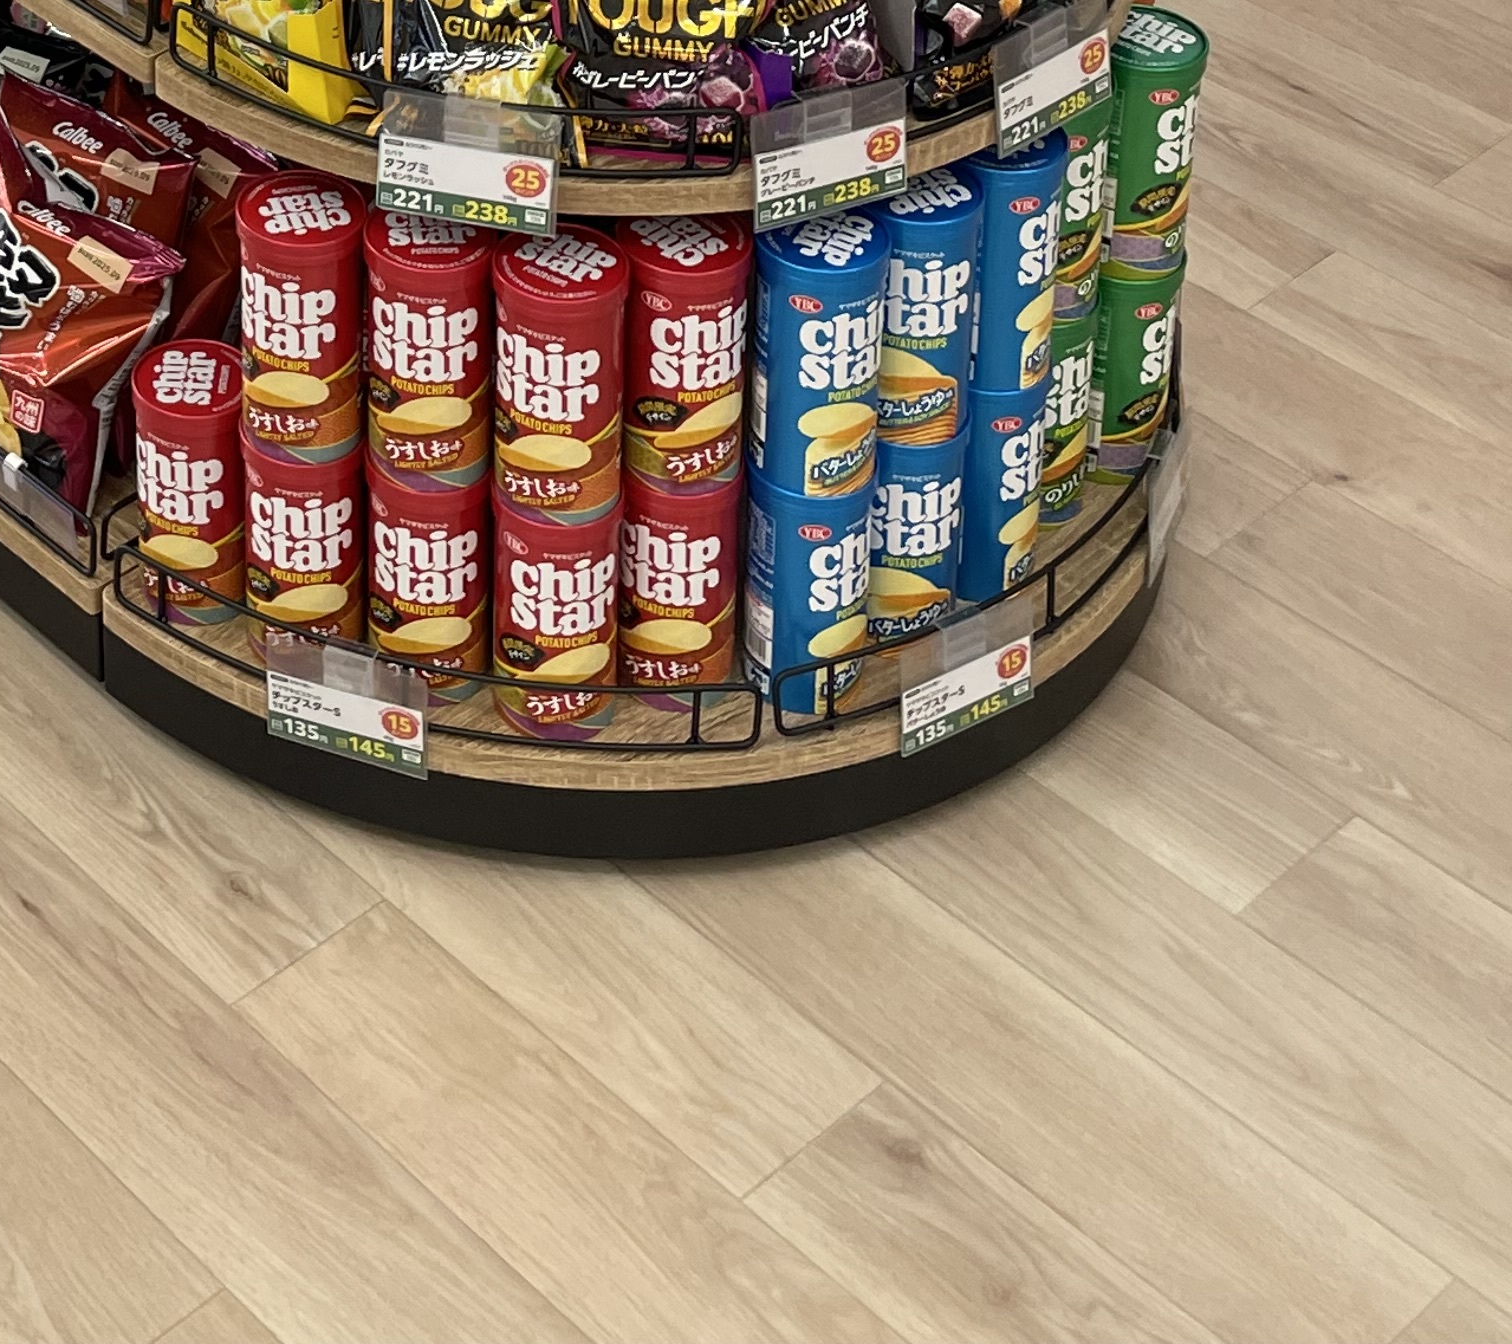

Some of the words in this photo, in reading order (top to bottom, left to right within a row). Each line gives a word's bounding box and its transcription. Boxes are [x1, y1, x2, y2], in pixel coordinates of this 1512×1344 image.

[444, 15, 540, 44] GUMMY
[614, 32, 713, 63] GUMMY
[1081, 49, 1104, 73] 25
[1151, 90, 1178, 105] YBC
[52, 121, 104, 154] Calbee
[147, 112, 193, 149] Calbee
[871, 132, 896, 155] 25
[384, 157, 429, 175] タフグミ
[510, 169, 539, 191] 25
[760, 169, 800, 186] タフグミ
[1010, 197, 1041, 213] YBC
[644, 293, 669, 310] YBC
[790, 295, 823, 311] YBC
[919, 336, 947, 349] CHIPS
[391, 377, 424, 396] POTATO
[426, 383, 454, 396] CHIPS
[542, 421, 572, 435] CHIPS
[993, 418, 1023, 433] YBC
[803, 525, 831, 542] YBC
[535, 635, 571, 649] POTATO
[1000, 651, 1022, 672] 15
[386, 712, 413, 734] 15
